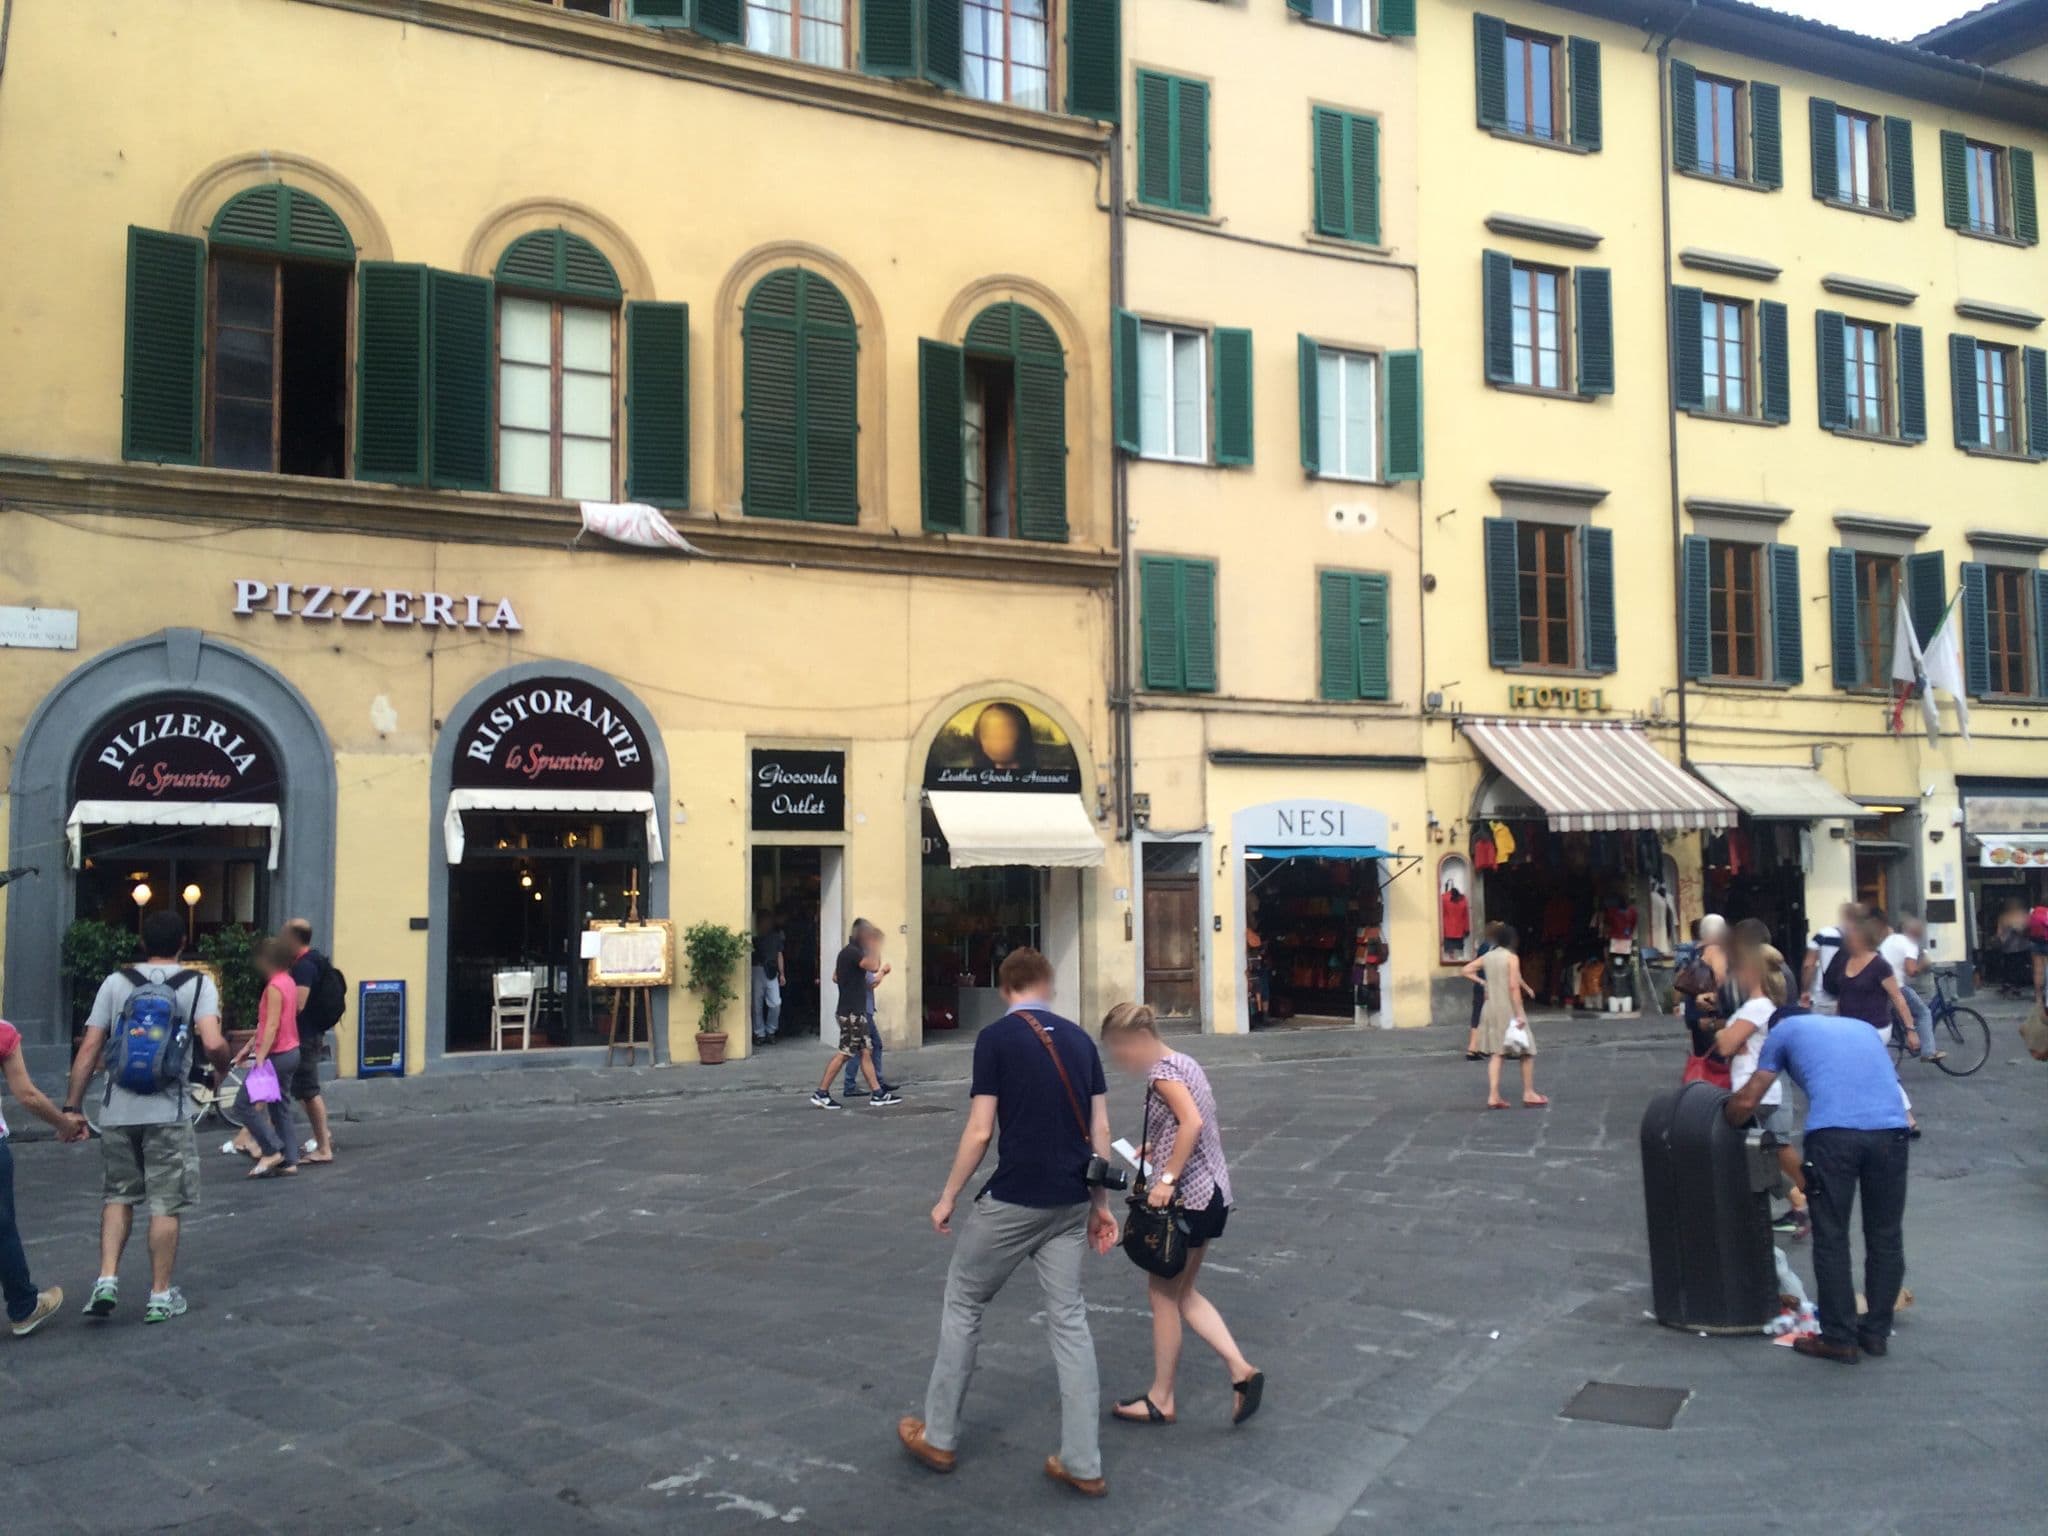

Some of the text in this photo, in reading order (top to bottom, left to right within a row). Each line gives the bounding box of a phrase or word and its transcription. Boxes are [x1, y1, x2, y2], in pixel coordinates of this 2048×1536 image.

[232, 579, 523, 631] PIZZERIA
[1509, 686, 1612, 712] HOTEL
[467, 689, 641, 768] RISTORANTE
[98, 713, 257, 776] PIZZERIA
[505, 743, 605, 780] lo Spuntino
[758, 763, 838, 788] Gioconda
[937, 768, 978, 783] Leather
[980, 768, 1013, 785] Goods
[128, 761, 232, 796] lo Spuntino
[771, 793, 826, 814] Outlet
[1277, 809, 1345, 836] NESI
